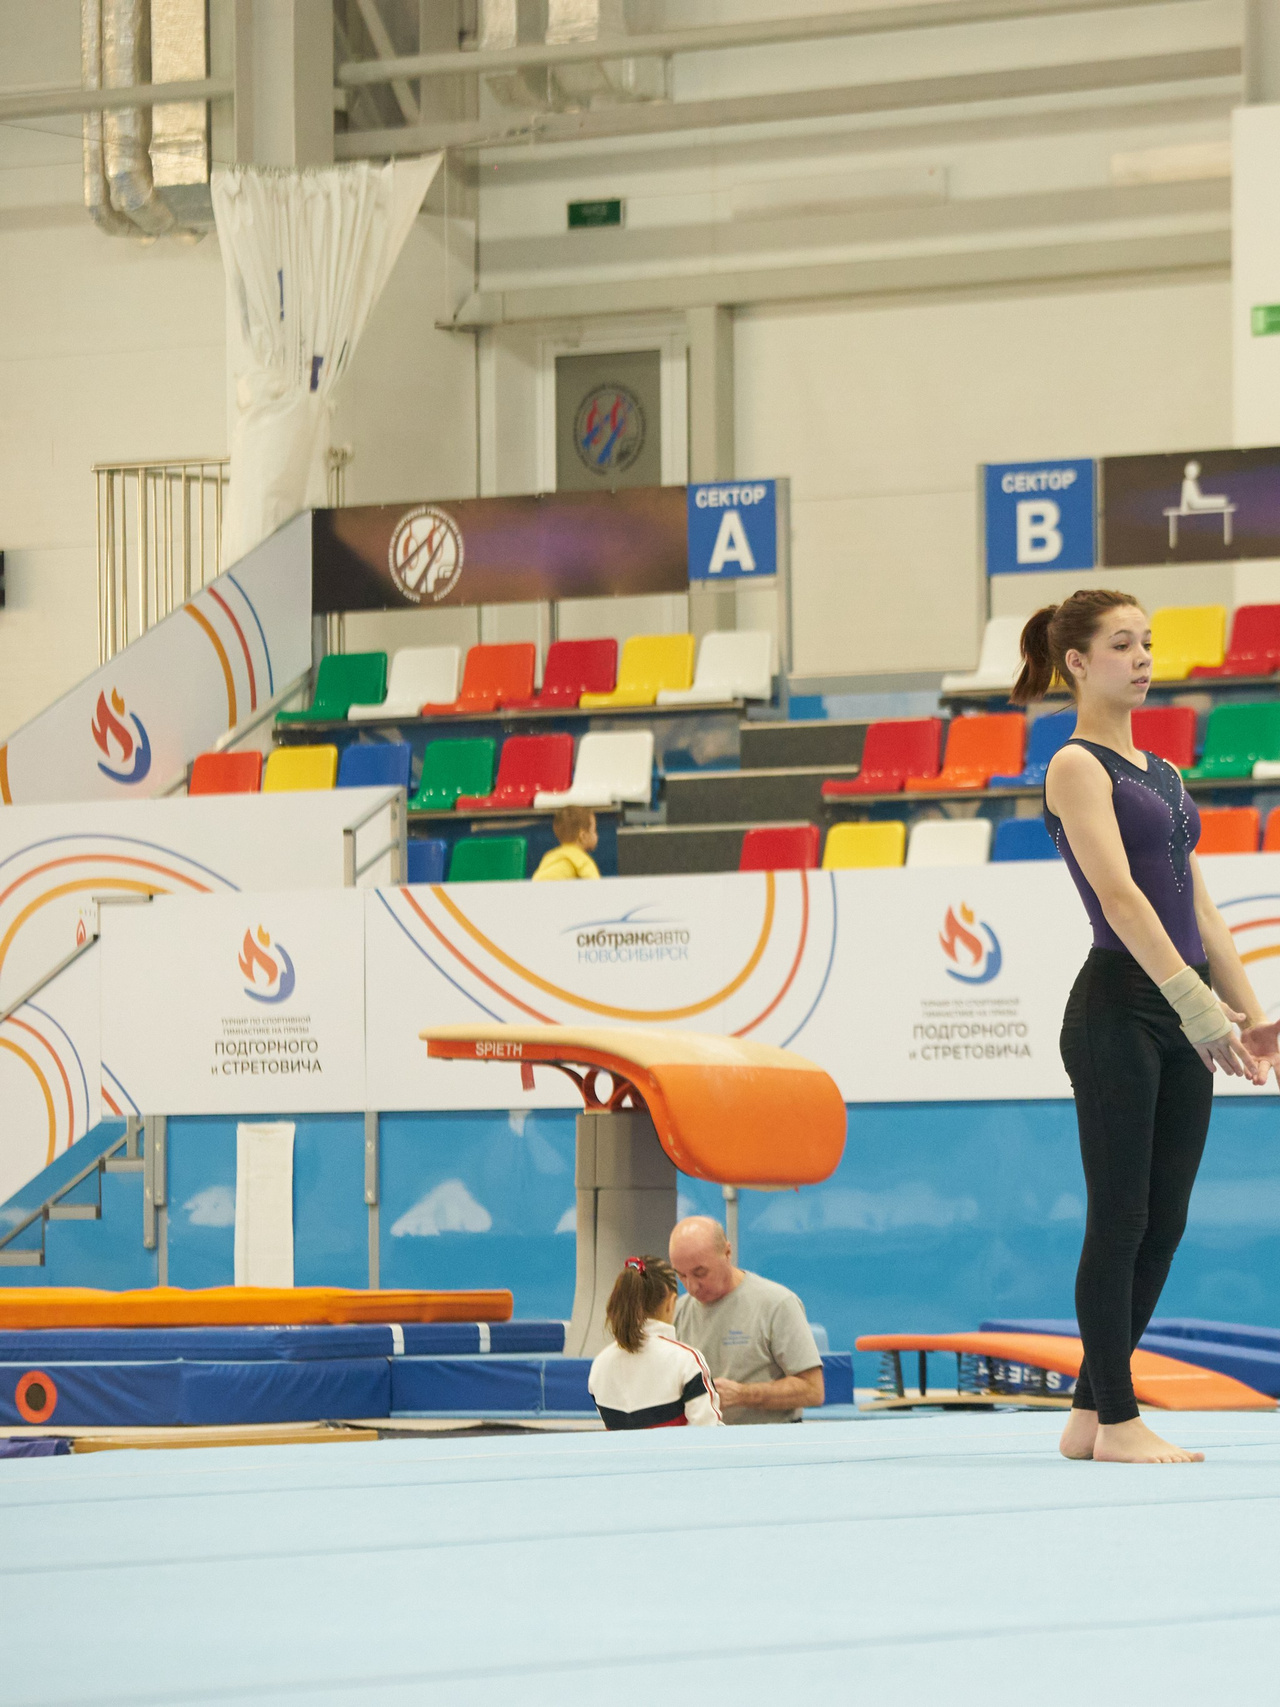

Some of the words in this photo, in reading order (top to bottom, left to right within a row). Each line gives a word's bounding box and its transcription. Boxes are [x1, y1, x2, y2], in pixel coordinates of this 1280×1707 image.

[1001, 469, 1077, 494] СЕКТОР
[695, 485, 766, 509] СЕКТОР
[576, 929, 690, 951] сибтрансавто
[577, 947, 689, 964] НОВОСИБИРСК
[913, 1022, 1028, 1040] ПОДГОРНОГО
[214, 1039, 319, 1057] ПОДГОРНОГО
[475, 1040, 523, 1057] SPIETH
[920, 1043, 1031, 1060] СТРЕТОВИЧА
[211, 1065, 218, 1076] и
[222, 1058, 323, 1076] СТРЕТОВИЧА
